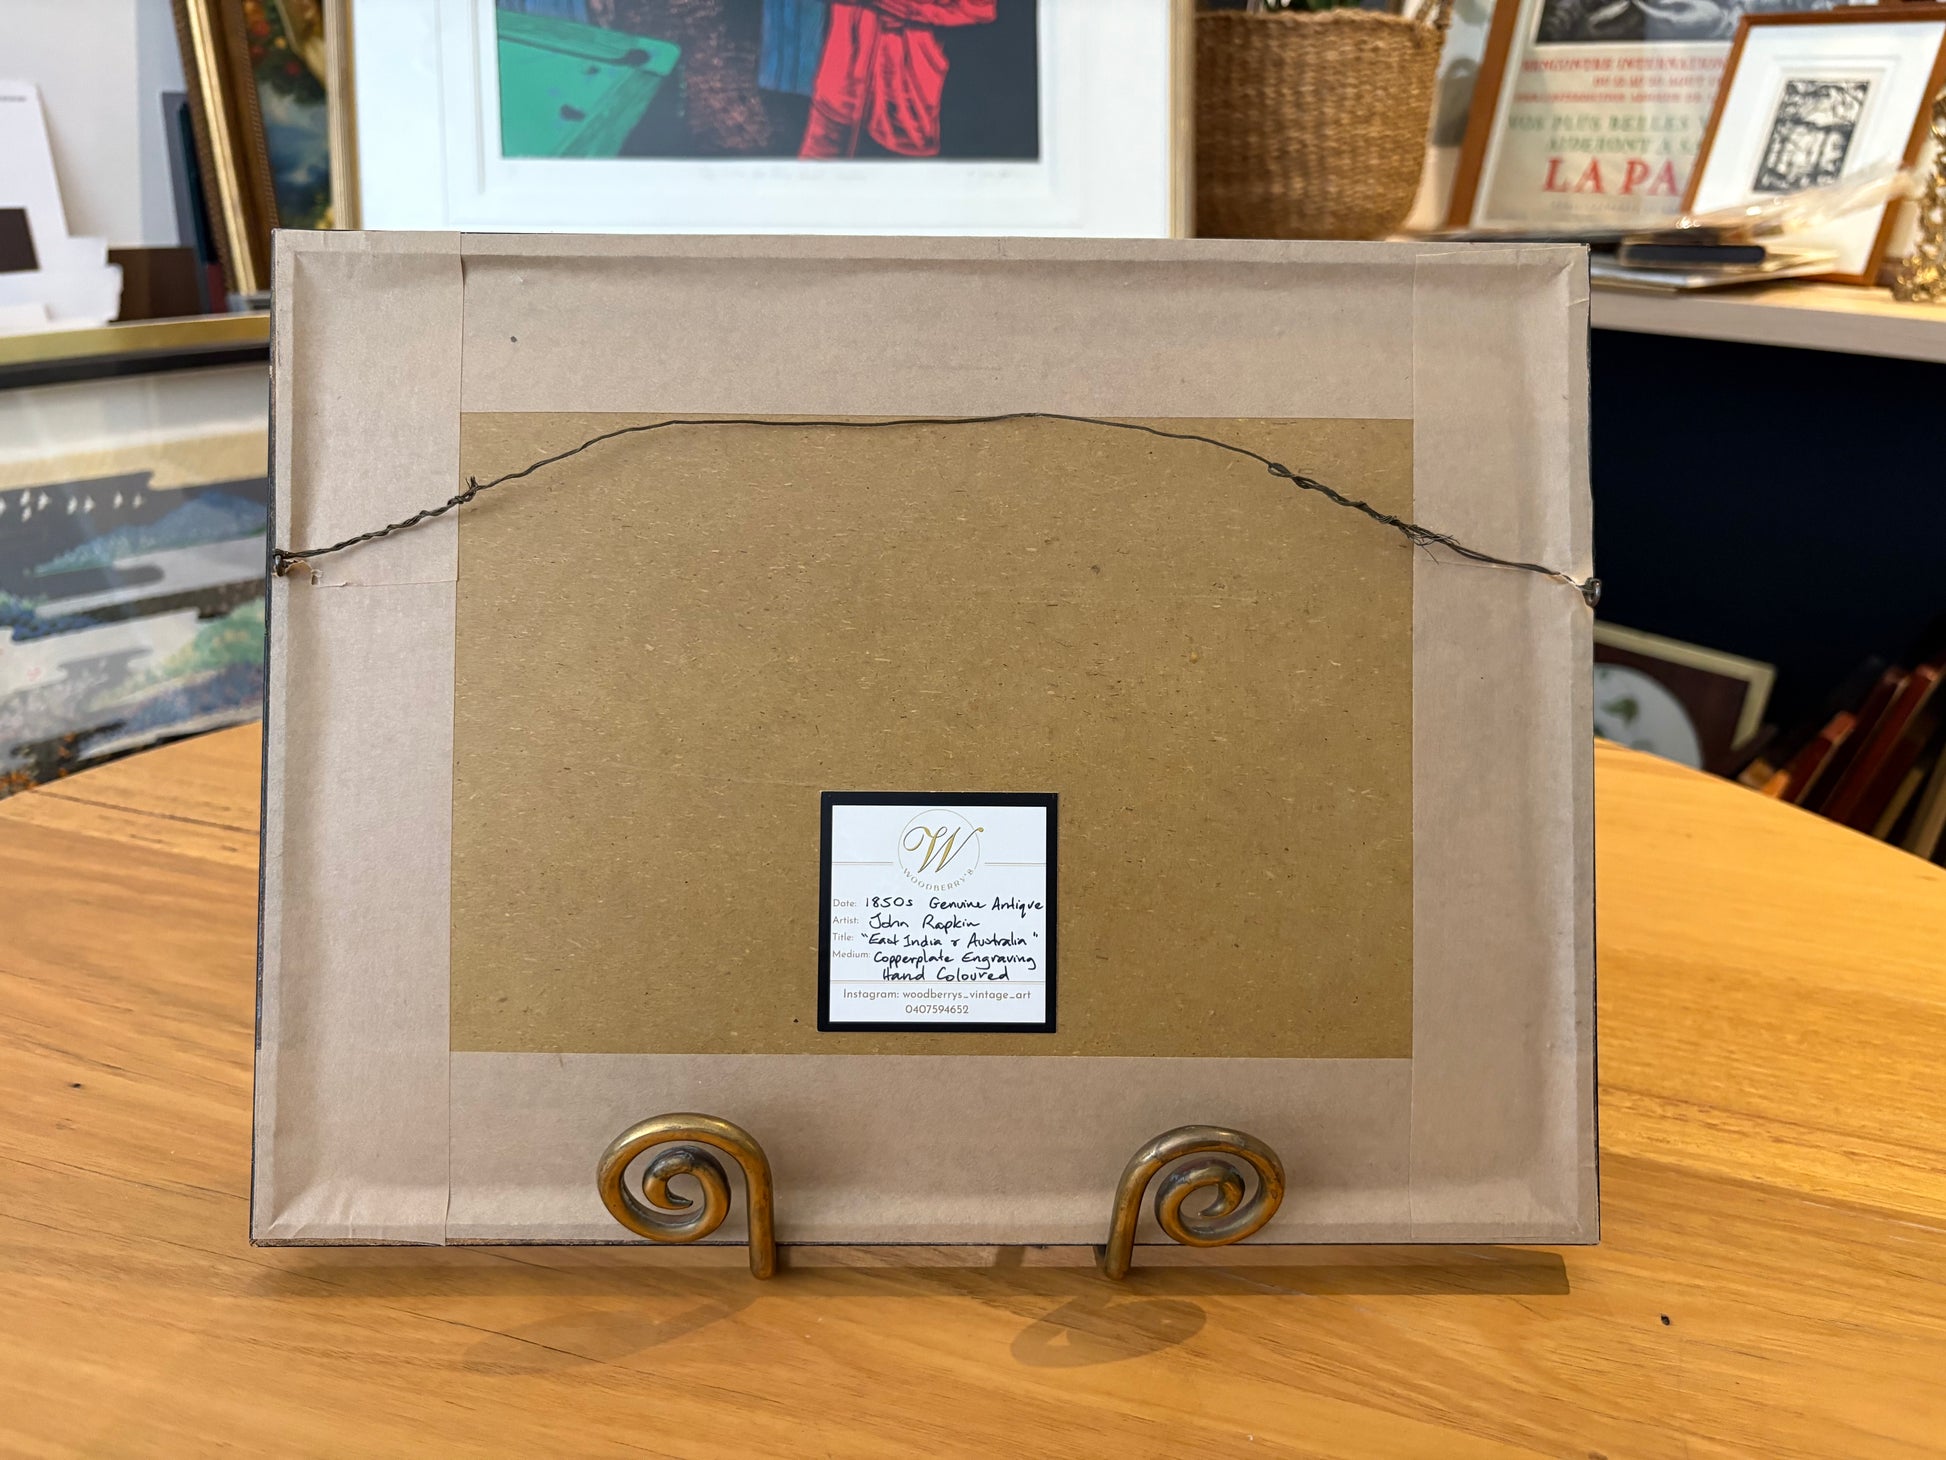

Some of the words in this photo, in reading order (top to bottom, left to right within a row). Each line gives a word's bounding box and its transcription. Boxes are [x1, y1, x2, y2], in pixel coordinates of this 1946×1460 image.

[1542, 156, 1605, 194] LA
[1619, 157, 1682, 197] PA
[833, 899, 857, 908] Date:
[865, 896, 914, 908] 1850s
[929, 897, 987, 910] Genuine
[991, 897, 1044, 918] Antique
[833, 916, 859, 925] Artist:
[869, 912, 910, 929] John
[832, 933, 854, 942] Title:
[903, 934, 943, 948] India
[832, 950, 871, 959] Medium:
[873, 948, 955, 968] Copperplate
[961, 951, 1038, 970] Engraving
[882, 966, 926, 981] Hand
[936, 966, 1010, 982] Coloured
[843, 988, 900, 1000] Instagram:
[902, 988, 1032, 1001] woodberrys_vintage_art
[905, 1004, 970, 1015] 0407594652
